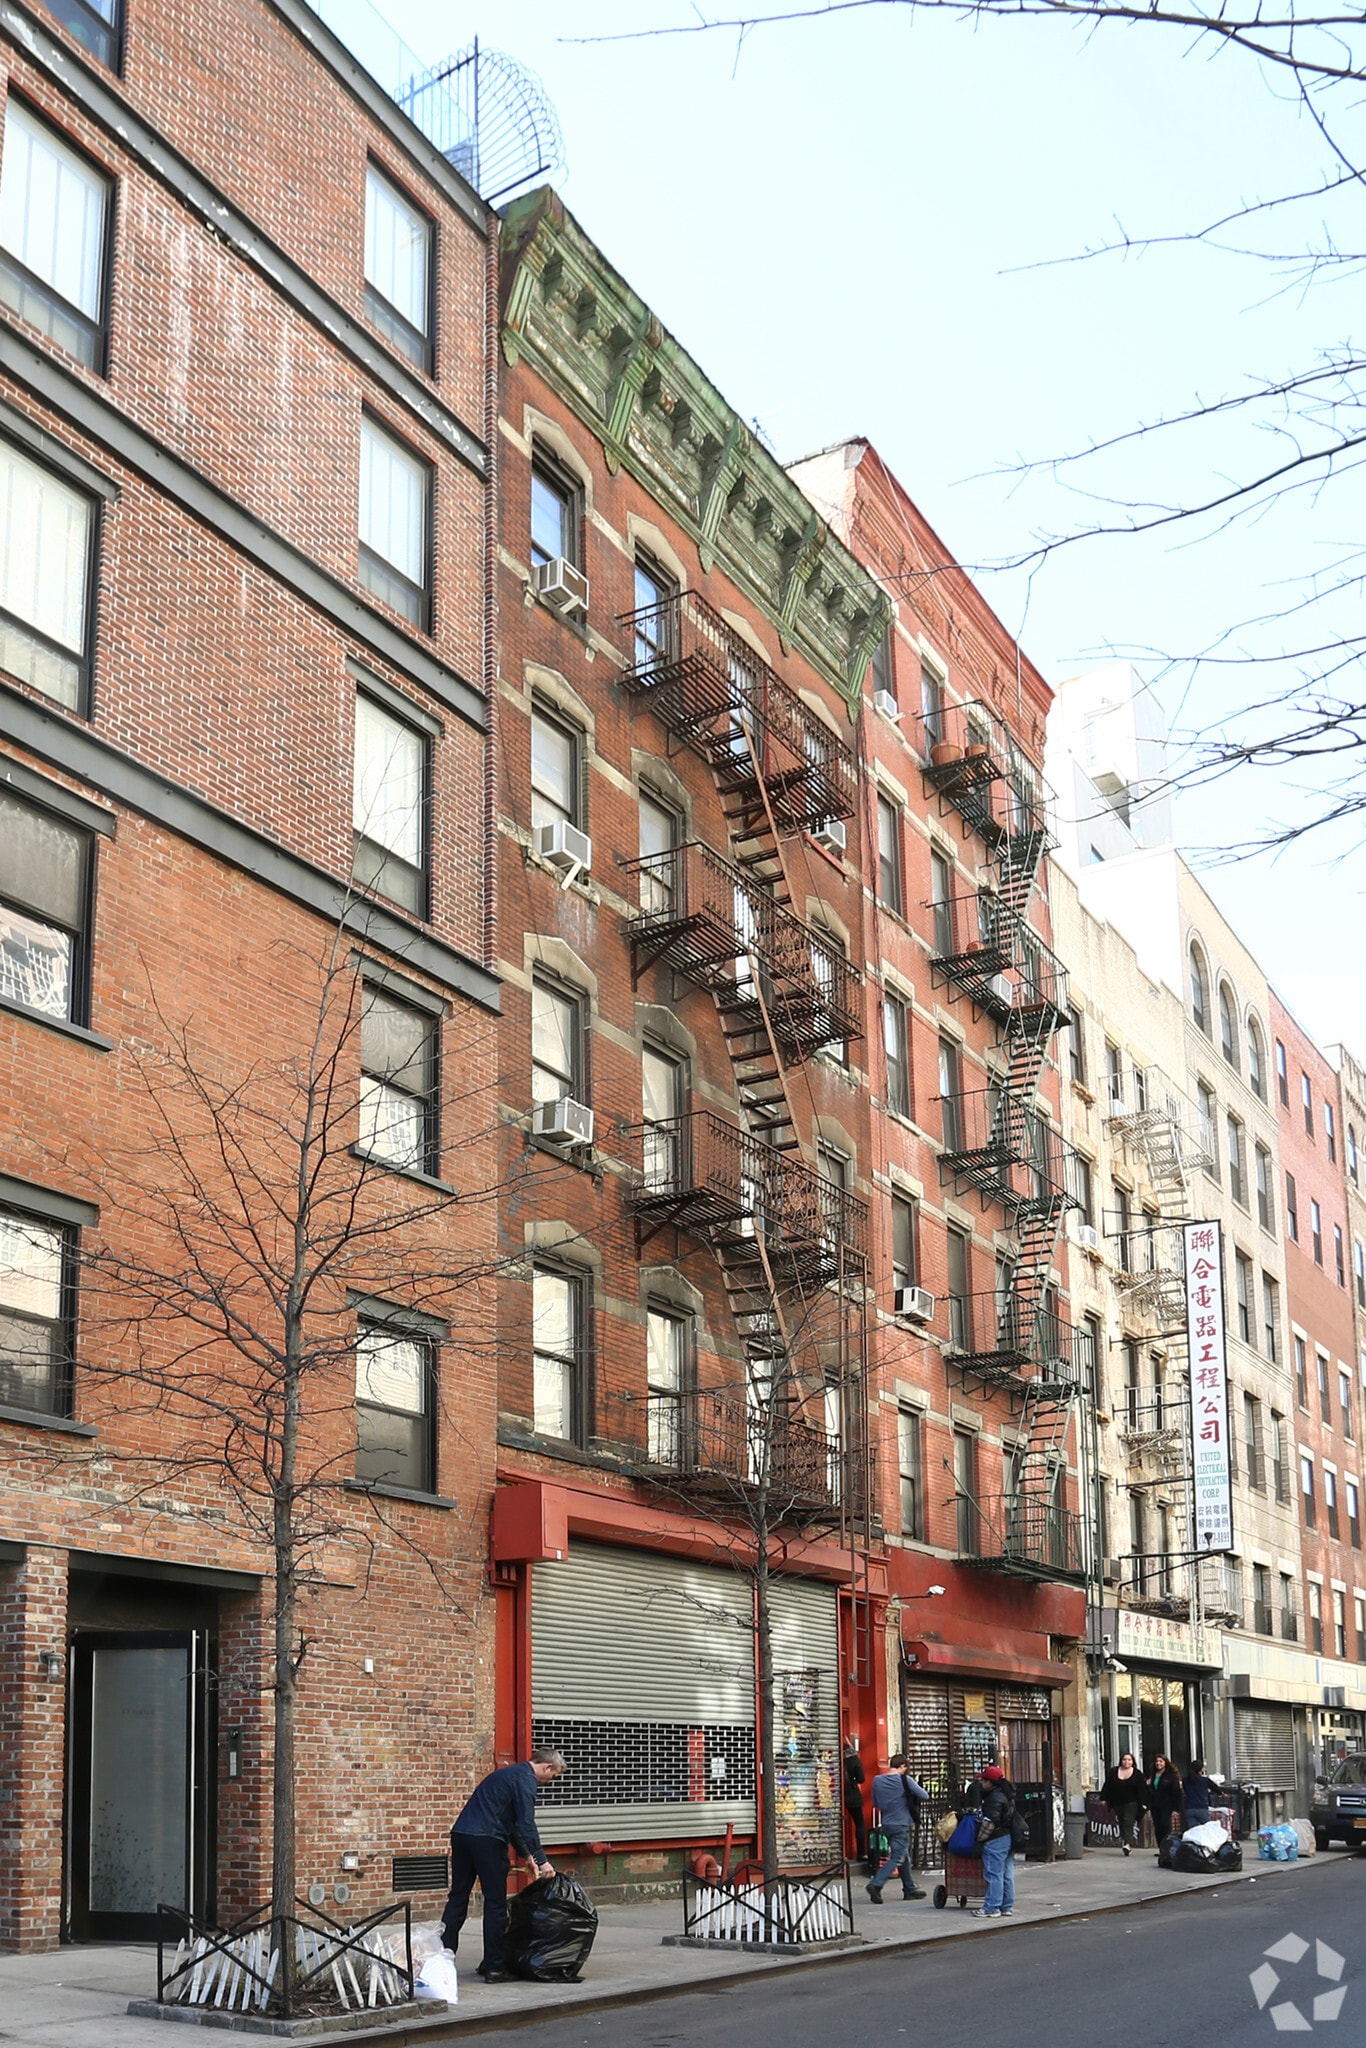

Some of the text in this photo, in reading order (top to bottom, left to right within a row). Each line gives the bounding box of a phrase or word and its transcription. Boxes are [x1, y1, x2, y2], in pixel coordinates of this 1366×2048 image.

[1190, 1228, 1222, 1443] 聯合電器工程公司
[1200, 1451, 1222, 1462] UNITED
